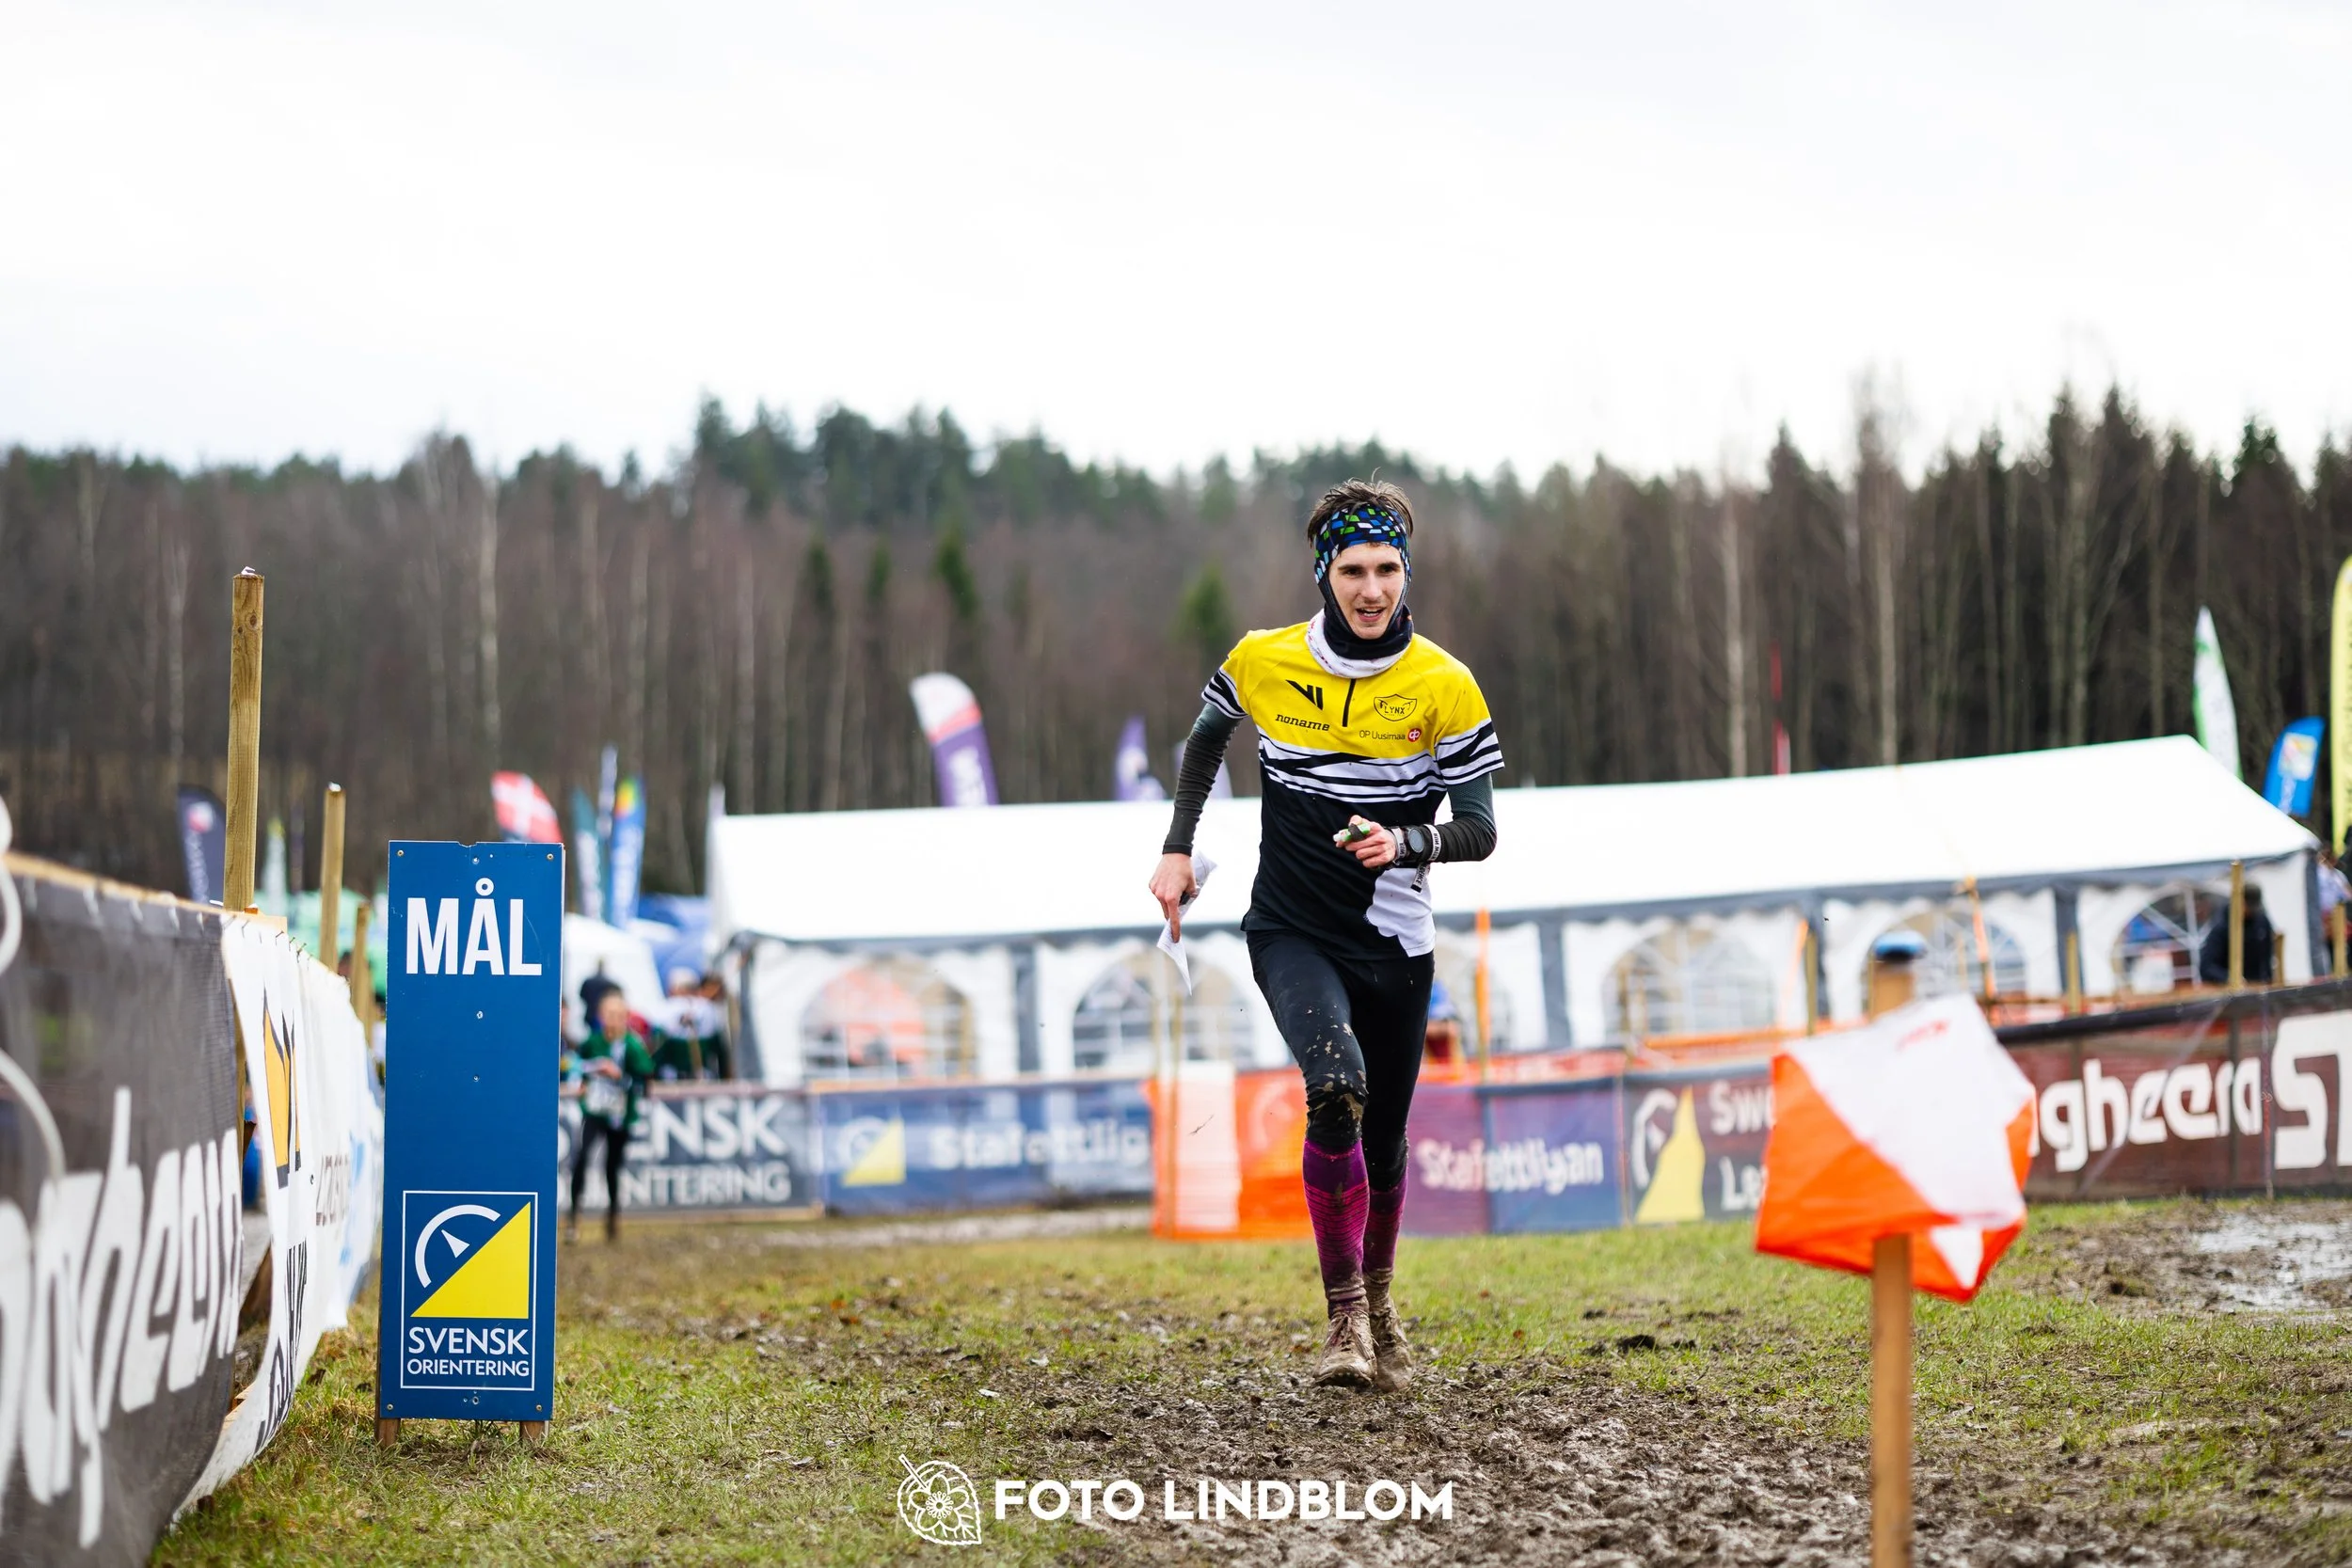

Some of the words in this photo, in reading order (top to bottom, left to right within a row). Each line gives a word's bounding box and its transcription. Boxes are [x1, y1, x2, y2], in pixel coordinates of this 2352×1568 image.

[1384, 705, 1406, 715] LYNX
[1275, 713, 1330, 732] noname
[1359, 730, 1370, 738] OP
[1372, 730, 1406, 740] Uusimaa
[406, 878, 542, 975] MÅL
[2027, 1057, 2263, 1173] gheera
[552, 1096, 789, 1160] ENSK
[408, 1326, 529, 1355] SVENSK
[406, 1358, 530, 1377] ORIENTERING
